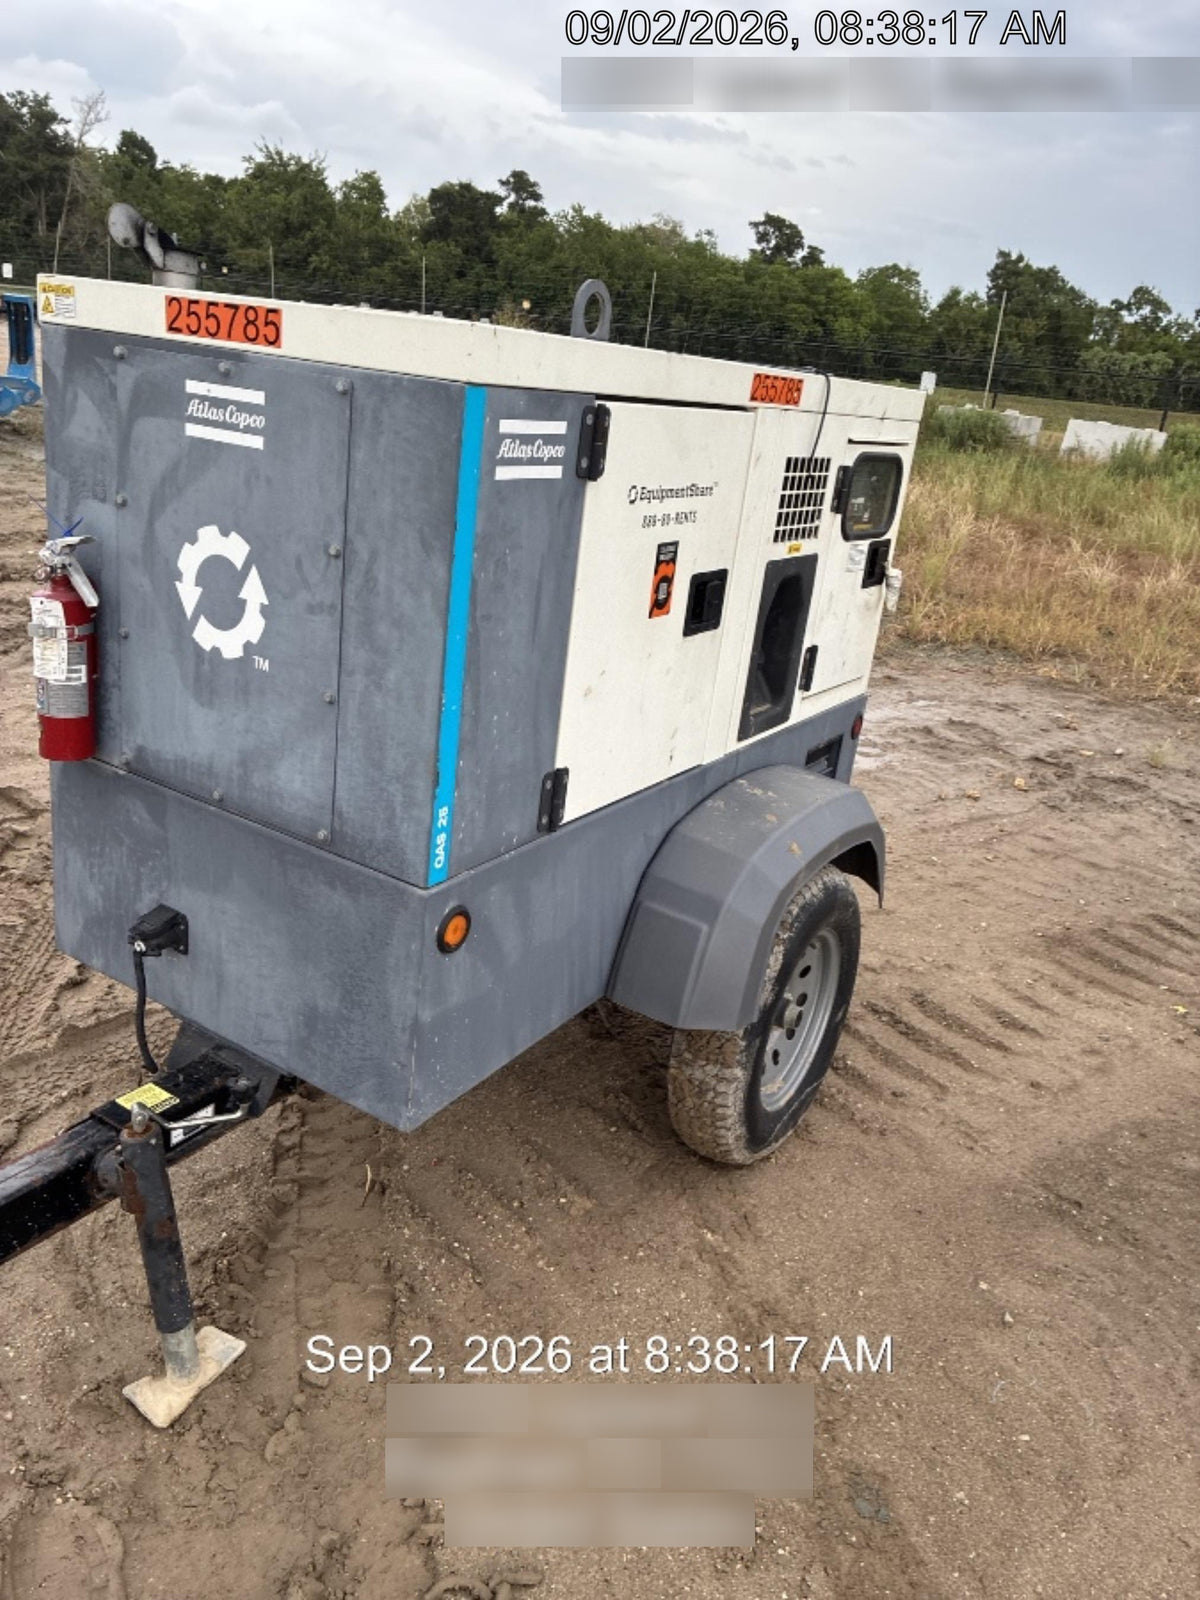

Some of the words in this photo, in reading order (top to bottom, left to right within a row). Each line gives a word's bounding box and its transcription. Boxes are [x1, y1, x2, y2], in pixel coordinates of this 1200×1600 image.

[168, 297, 280, 345] 255785
[751, 374, 802, 405] 255785
[185, 398, 225, 422] Atlas
[225, 404, 266, 429] Copco
[495, 438, 533, 459] Atlas
[532, 438, 566, 462] Copco
[433, 831, 447, 869] QAS
